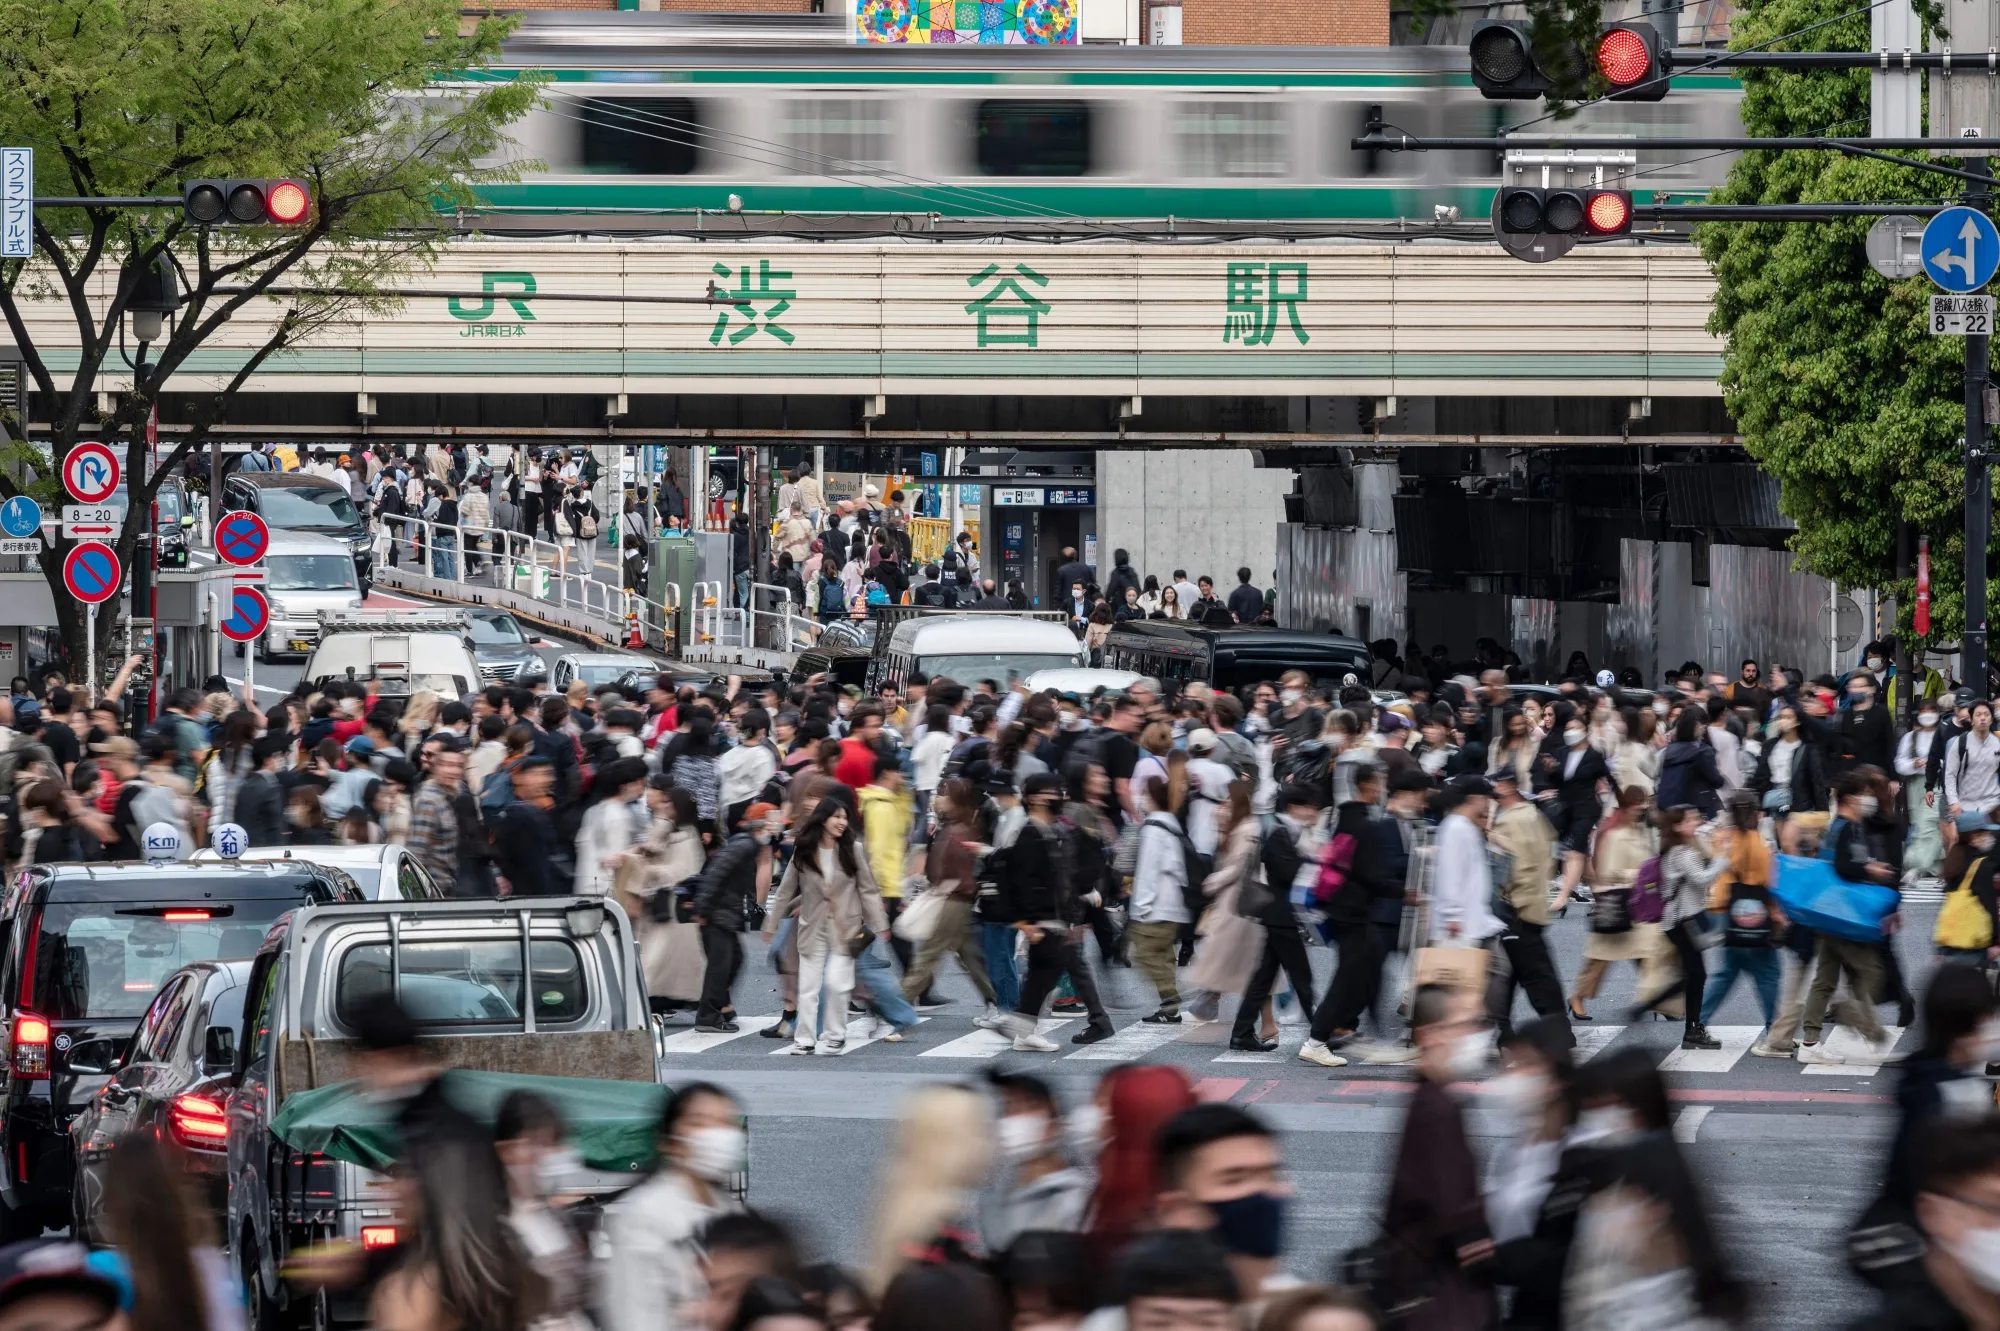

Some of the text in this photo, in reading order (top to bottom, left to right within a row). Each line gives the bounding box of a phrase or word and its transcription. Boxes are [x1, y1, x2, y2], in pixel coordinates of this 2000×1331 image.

[8, 153, 26, 252] スクランブル式
[448, 271, 537, 321] JR
[708, 259, 1311, 347] 渋谷駅
[1934, 297, 1989, 312] 路線バスを除く
[460, 324, 526, 337] JR東日本
[2, 543, 39, 552] 歩行者優先
[148, 836, 175, 847] km
[220, 828, 238, 855] 大和
